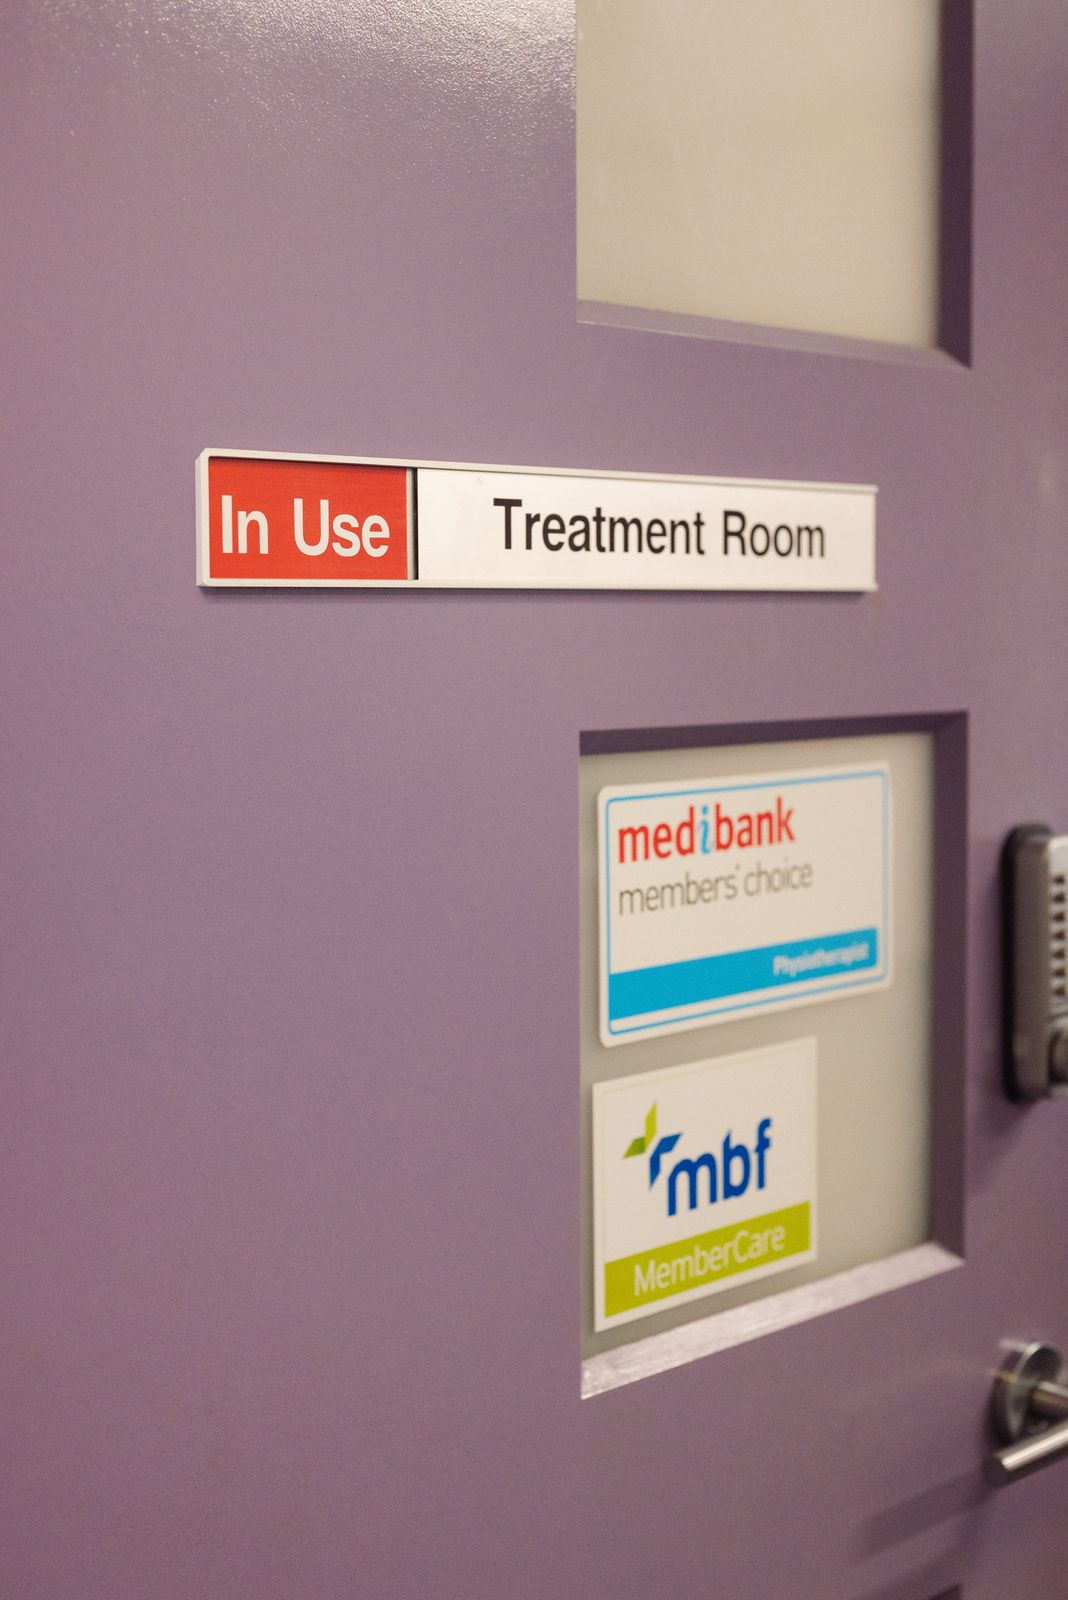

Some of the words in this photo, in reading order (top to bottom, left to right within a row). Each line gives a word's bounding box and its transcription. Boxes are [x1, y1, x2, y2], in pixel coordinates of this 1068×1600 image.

[220, 494, 270, 555] In
[293, 497, 391, 558] Use
[493, 497, 706, 557] Treatment
[722, 509, 826, 559] Room
[618, 796, 795, 864] medibank
[743, 857, 814, 898] choice
[667, 1116, 773, 1218] mbf
[633, 1225, 786, 1297] MemberCare
